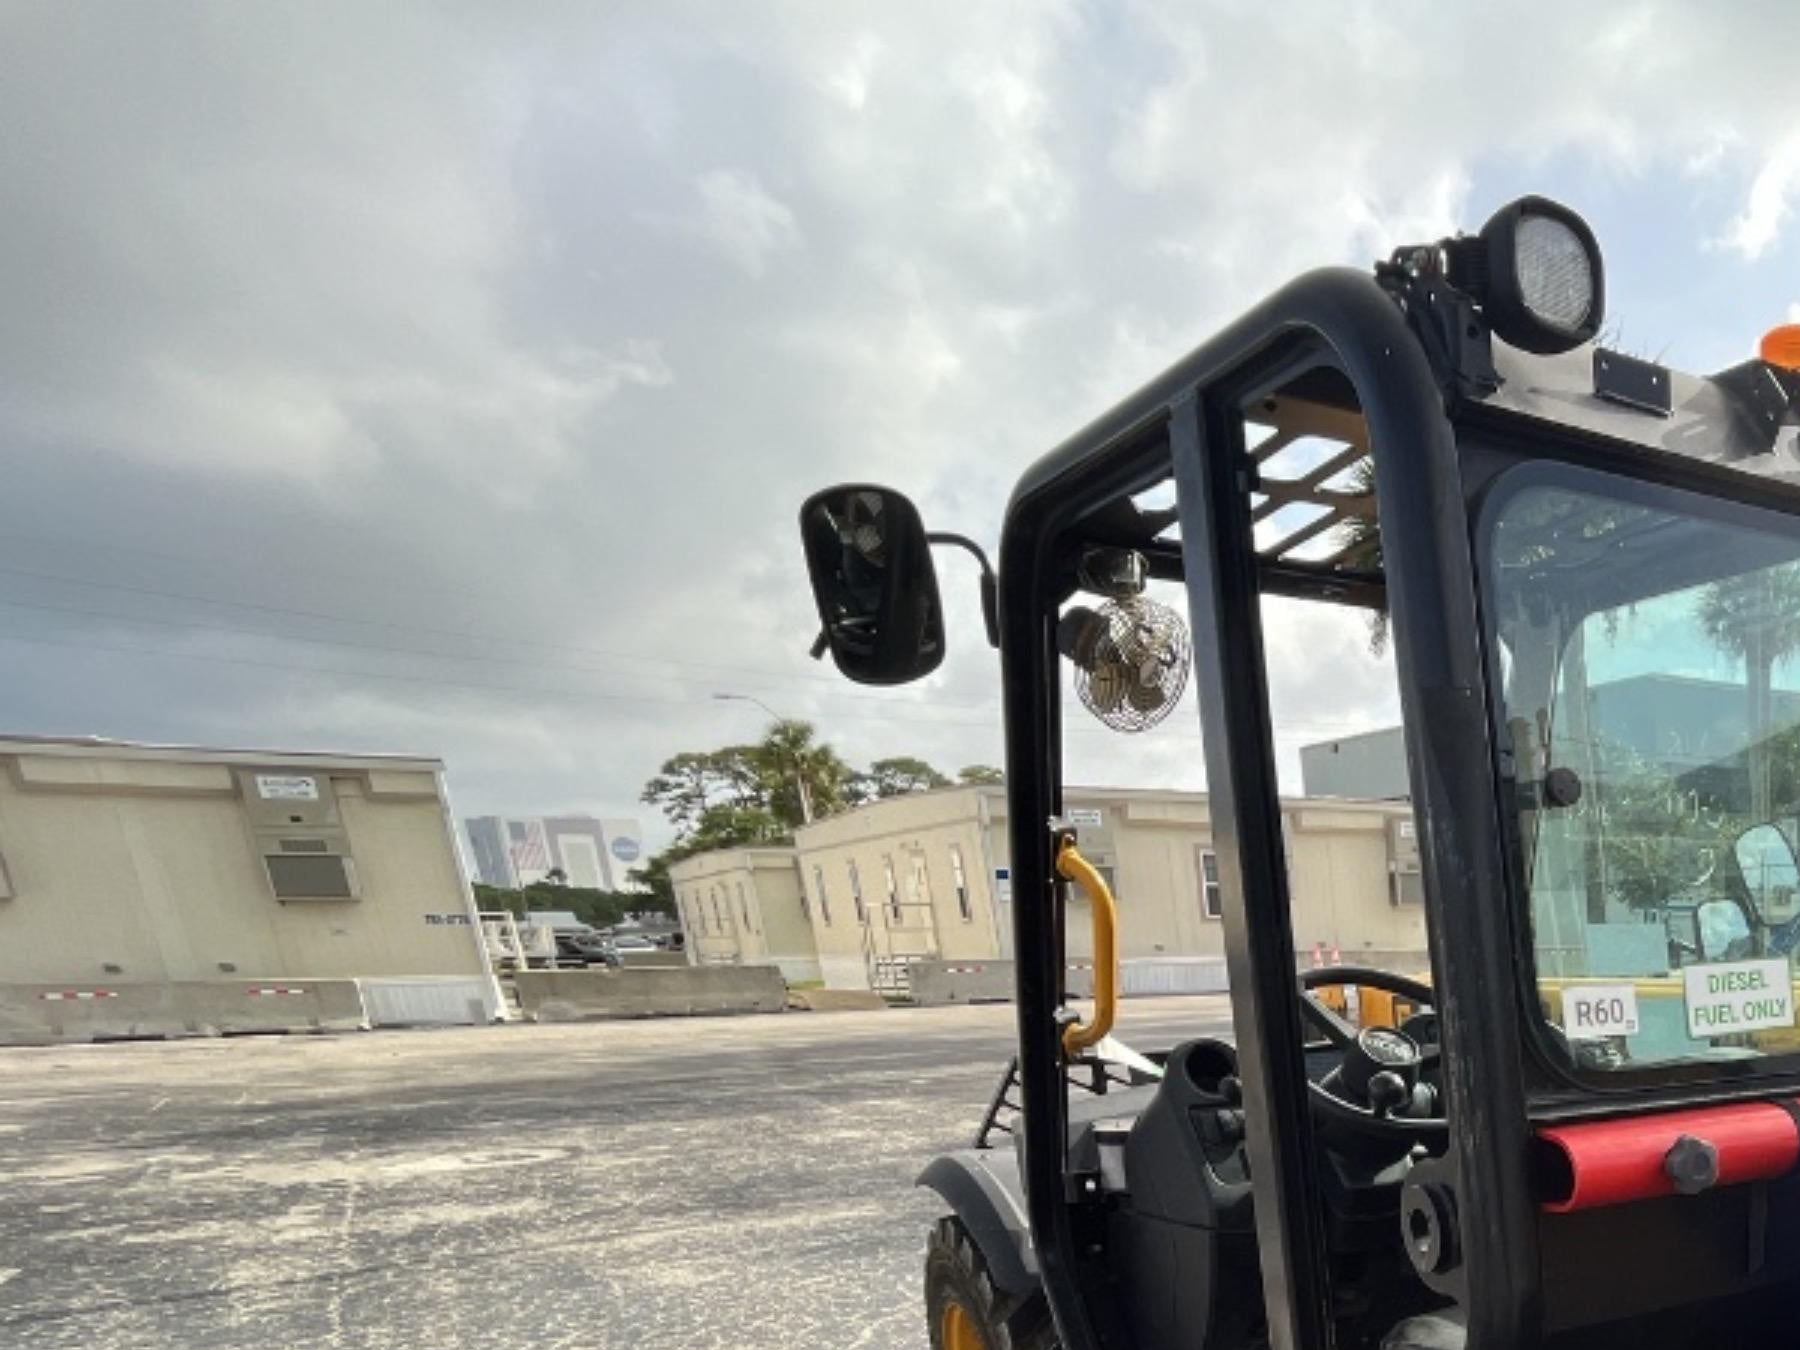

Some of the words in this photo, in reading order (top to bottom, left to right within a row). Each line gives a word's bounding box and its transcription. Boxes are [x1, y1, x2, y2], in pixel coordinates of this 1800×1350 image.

[1708, 969, 1770, 994] DIESEL
[1576, 998, 1624, 1027] R60
[1694, 1003, 1740, 1027] FUEL
[1743, 997, 1787, 1021] ONLY
